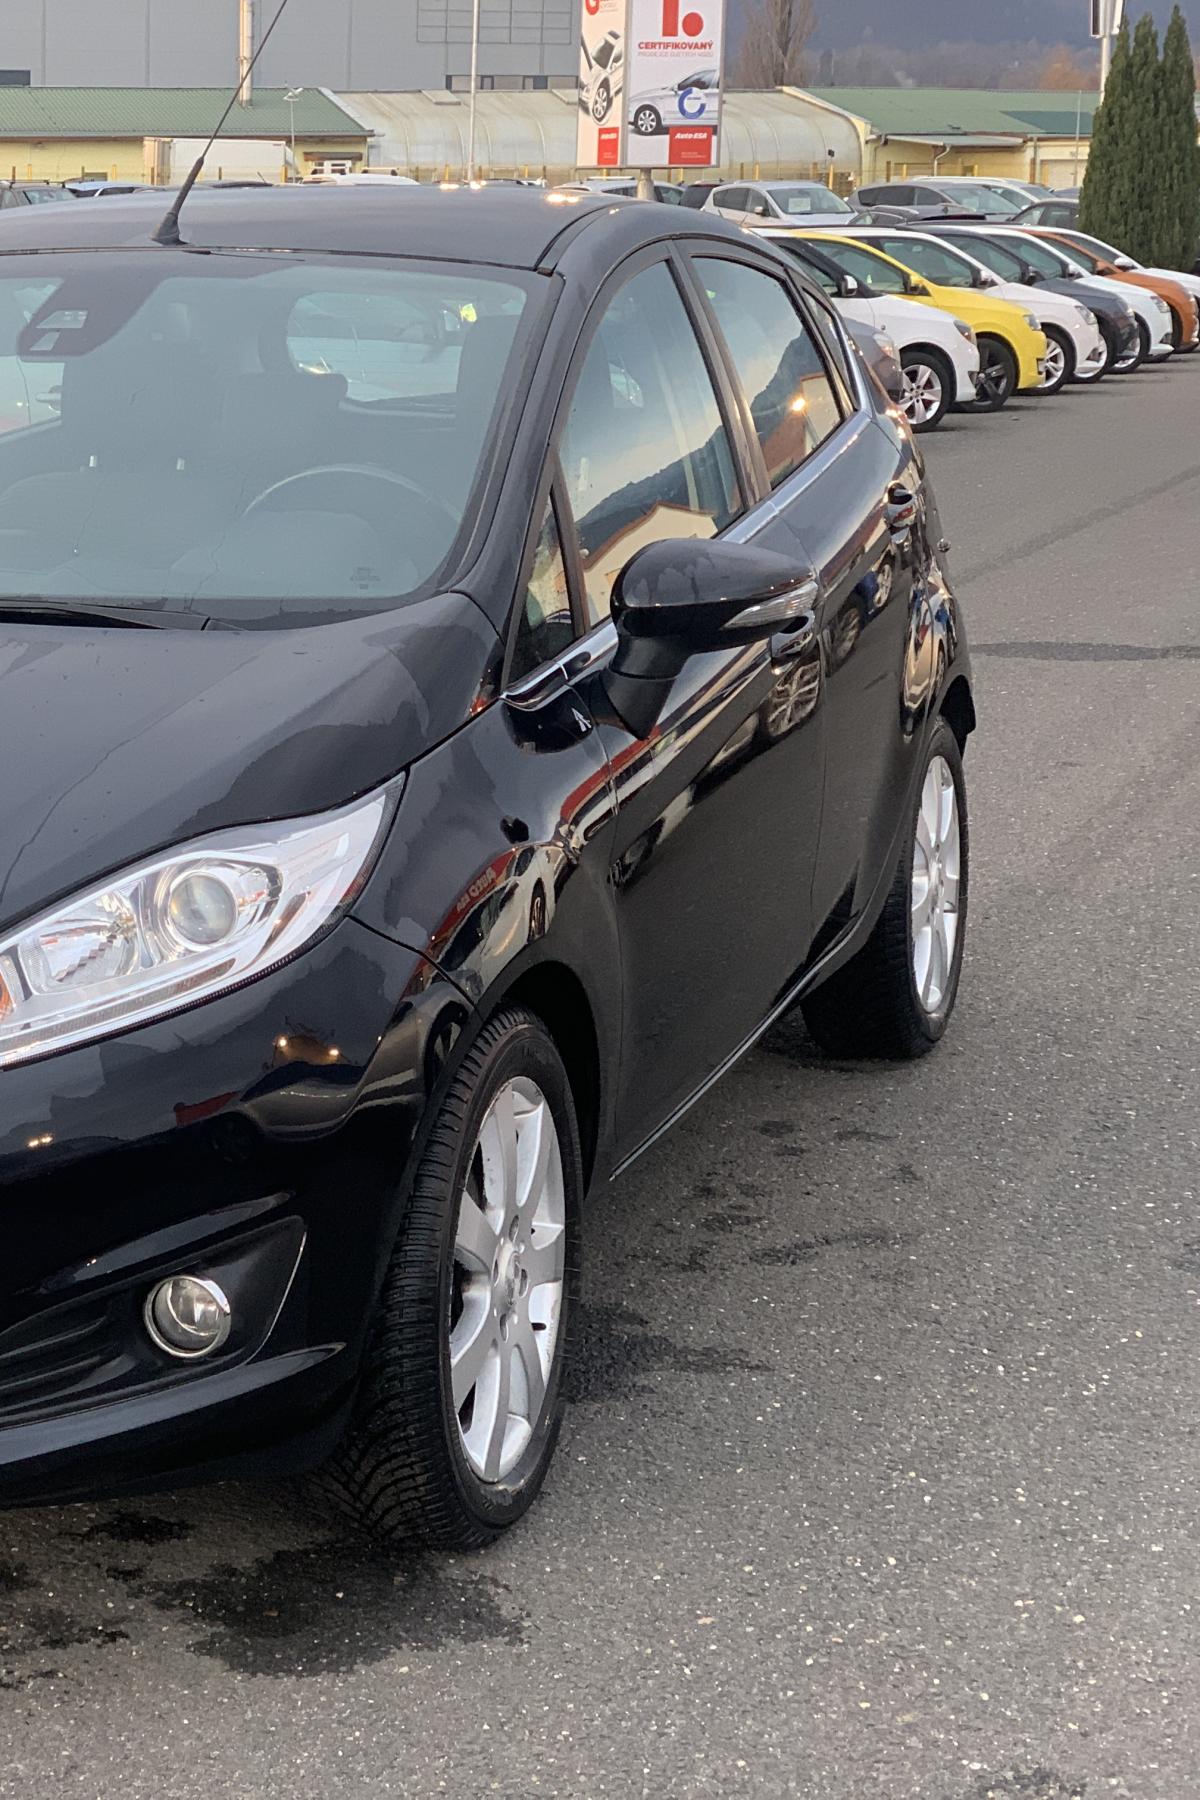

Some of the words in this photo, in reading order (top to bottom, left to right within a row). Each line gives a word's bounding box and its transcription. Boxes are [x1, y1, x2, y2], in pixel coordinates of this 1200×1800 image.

[638, 40, 714, 50] CERTIFIKOVANÝ
[675, 132, 693, 140] Auto
[693, 132, 708, 140] ESA
